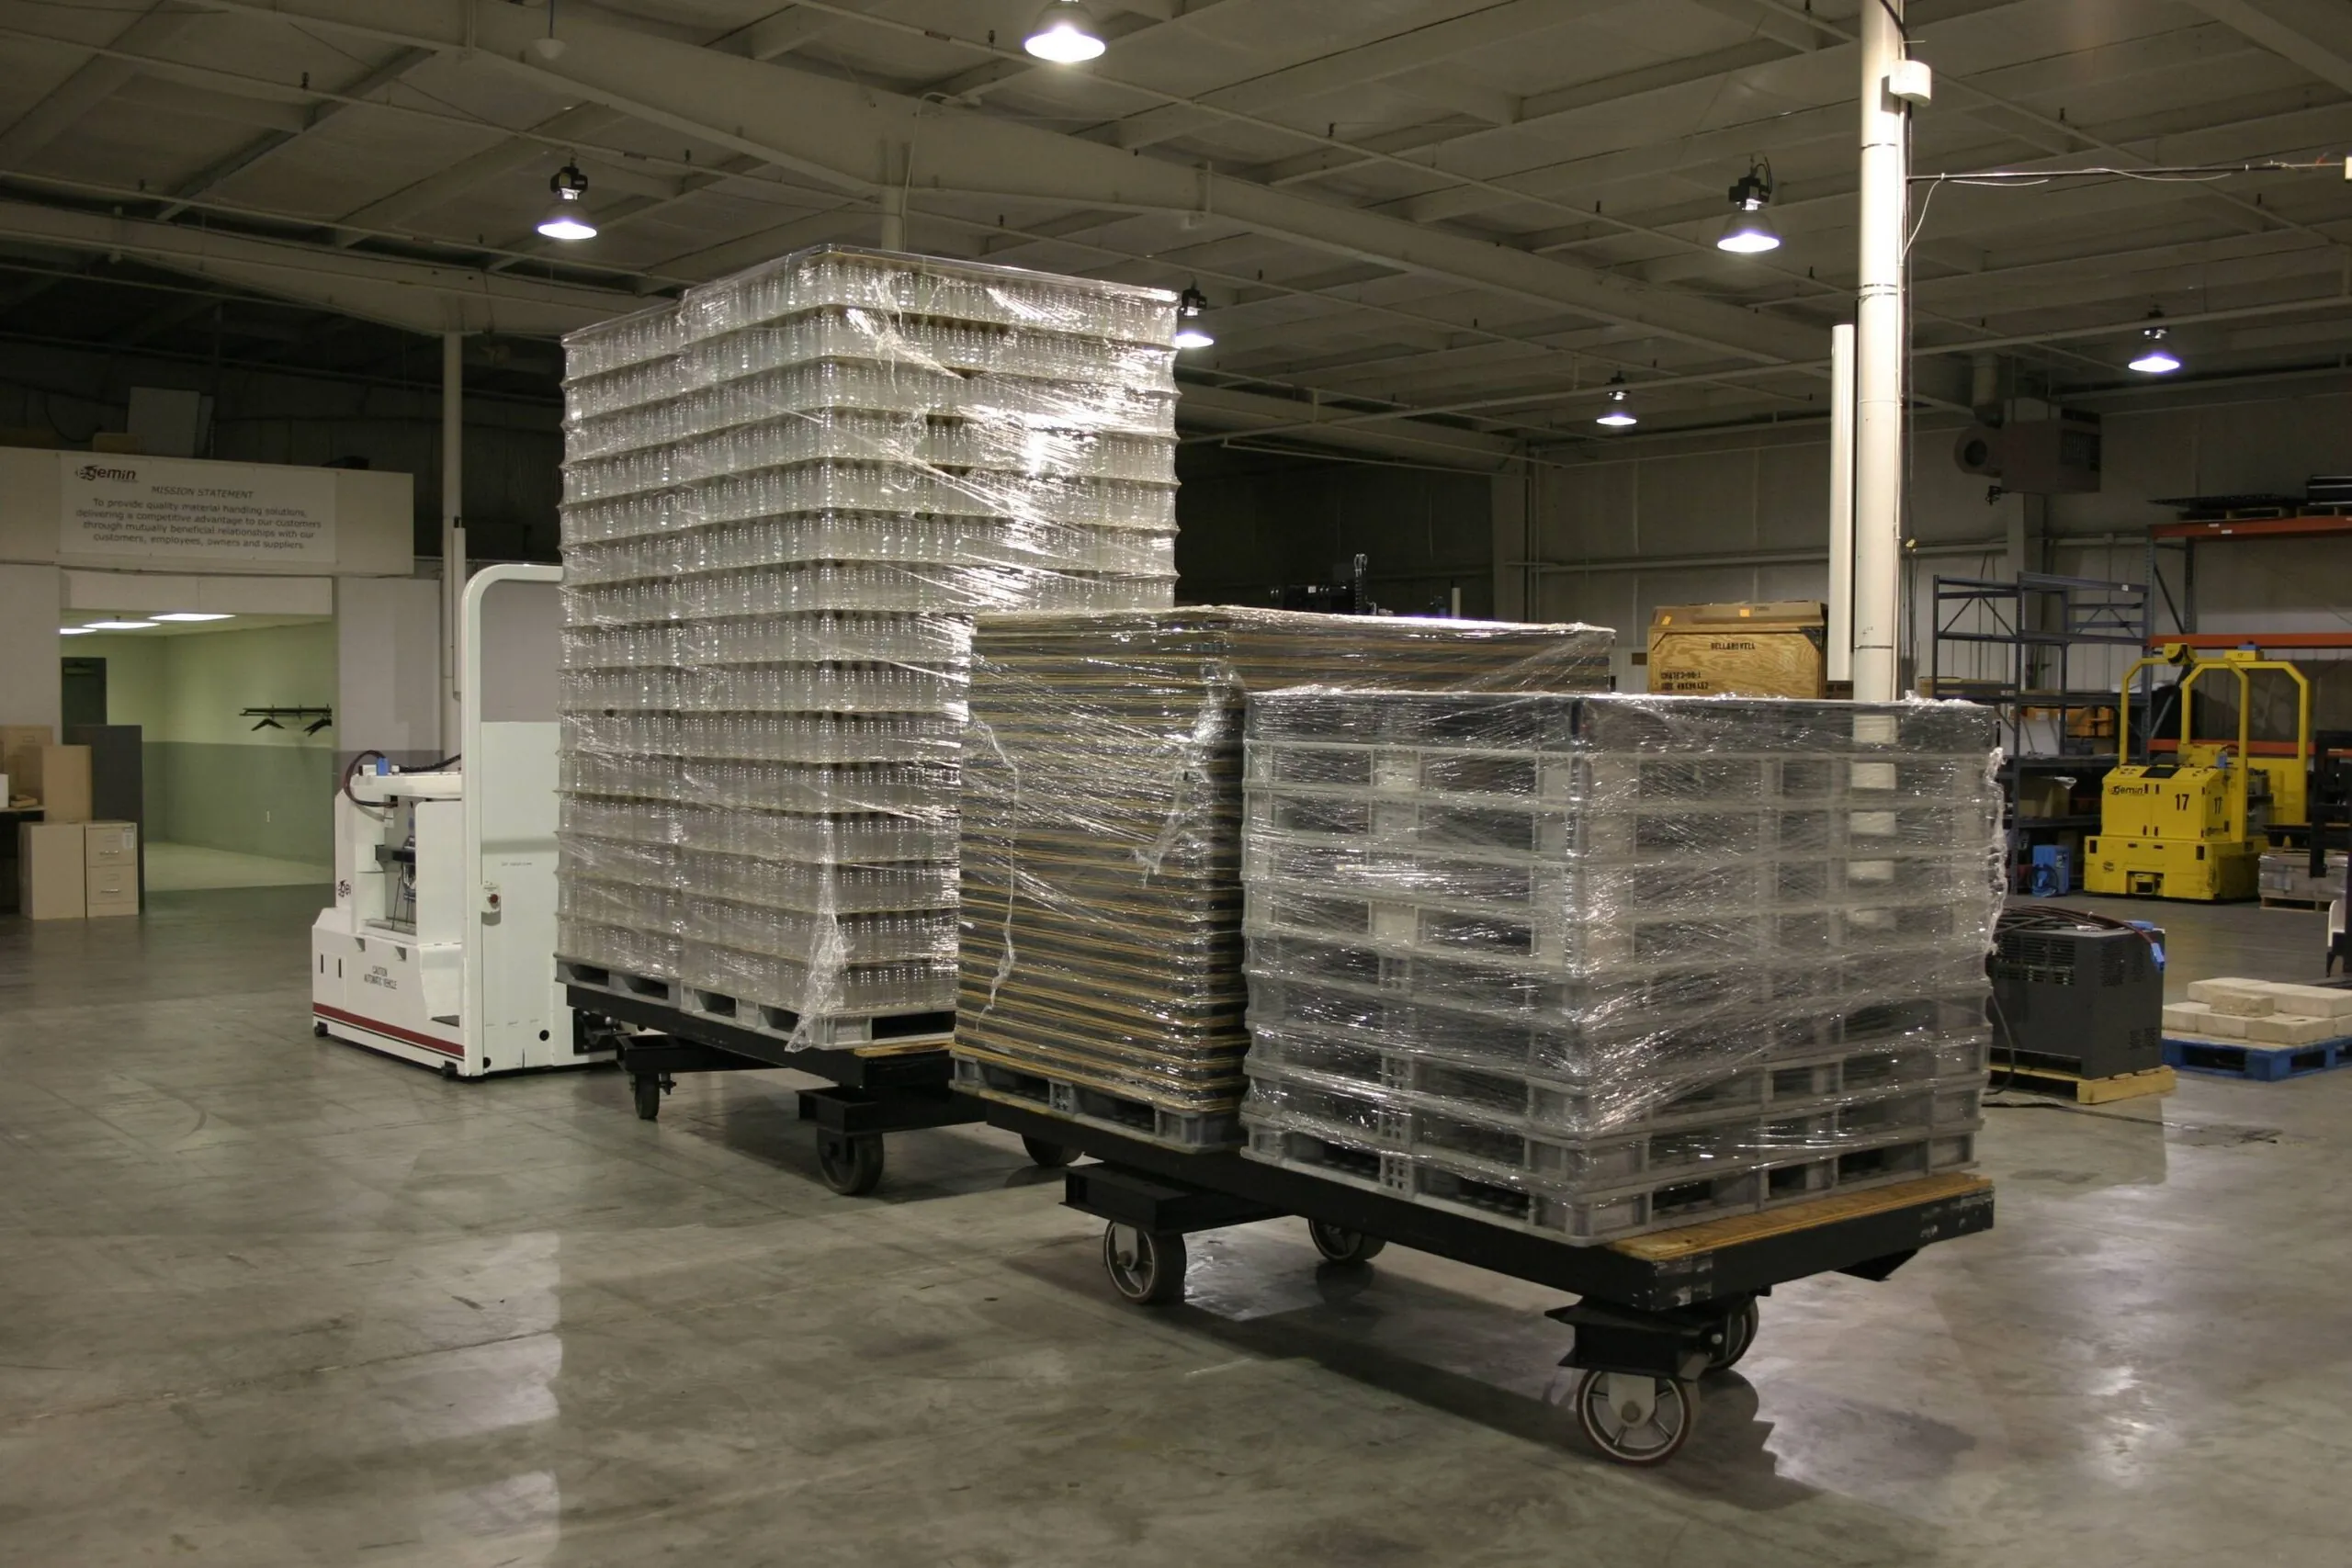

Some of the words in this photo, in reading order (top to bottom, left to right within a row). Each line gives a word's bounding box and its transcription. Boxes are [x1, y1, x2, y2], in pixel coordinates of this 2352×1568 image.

[151, 485, 195, 496] MISSION
[198, 488, 254, 499] STATEMENT
[93, 497, 104, 506] To
[107, 499, 144, 508] provide
[146, 500, 178, 511] quality
[182, 502, 220, 512] material
[223, 504, 263, 516] handling
[265, 506, 308, 518] solutions,
[76, 508, 125, 521] delivering
[136, 511, 192, 523] competitive
[194, 513, 243, 526] advantage
[245, 516, 255, 525] to
[257, 519, 274, 527] our
[276, 519, 322, 529] customers
[83, 520, 123, 532] through
[126, 522, 167, 534] mutually
[171, 524, 215, 535] beneficial
[218, 525, 276, 538] relationships
[278, 529, 298, 538] with
[300, 531, 315, 539] our
[93, 533, 148, 544] customers,
[151, 535, 204, 547] employees,
[207, 537, 241, 547] owners
[243, 539, 261, 547] and
[2175, 794, 2190, 811] 17
[2213, 796, 2223, 815] 17
